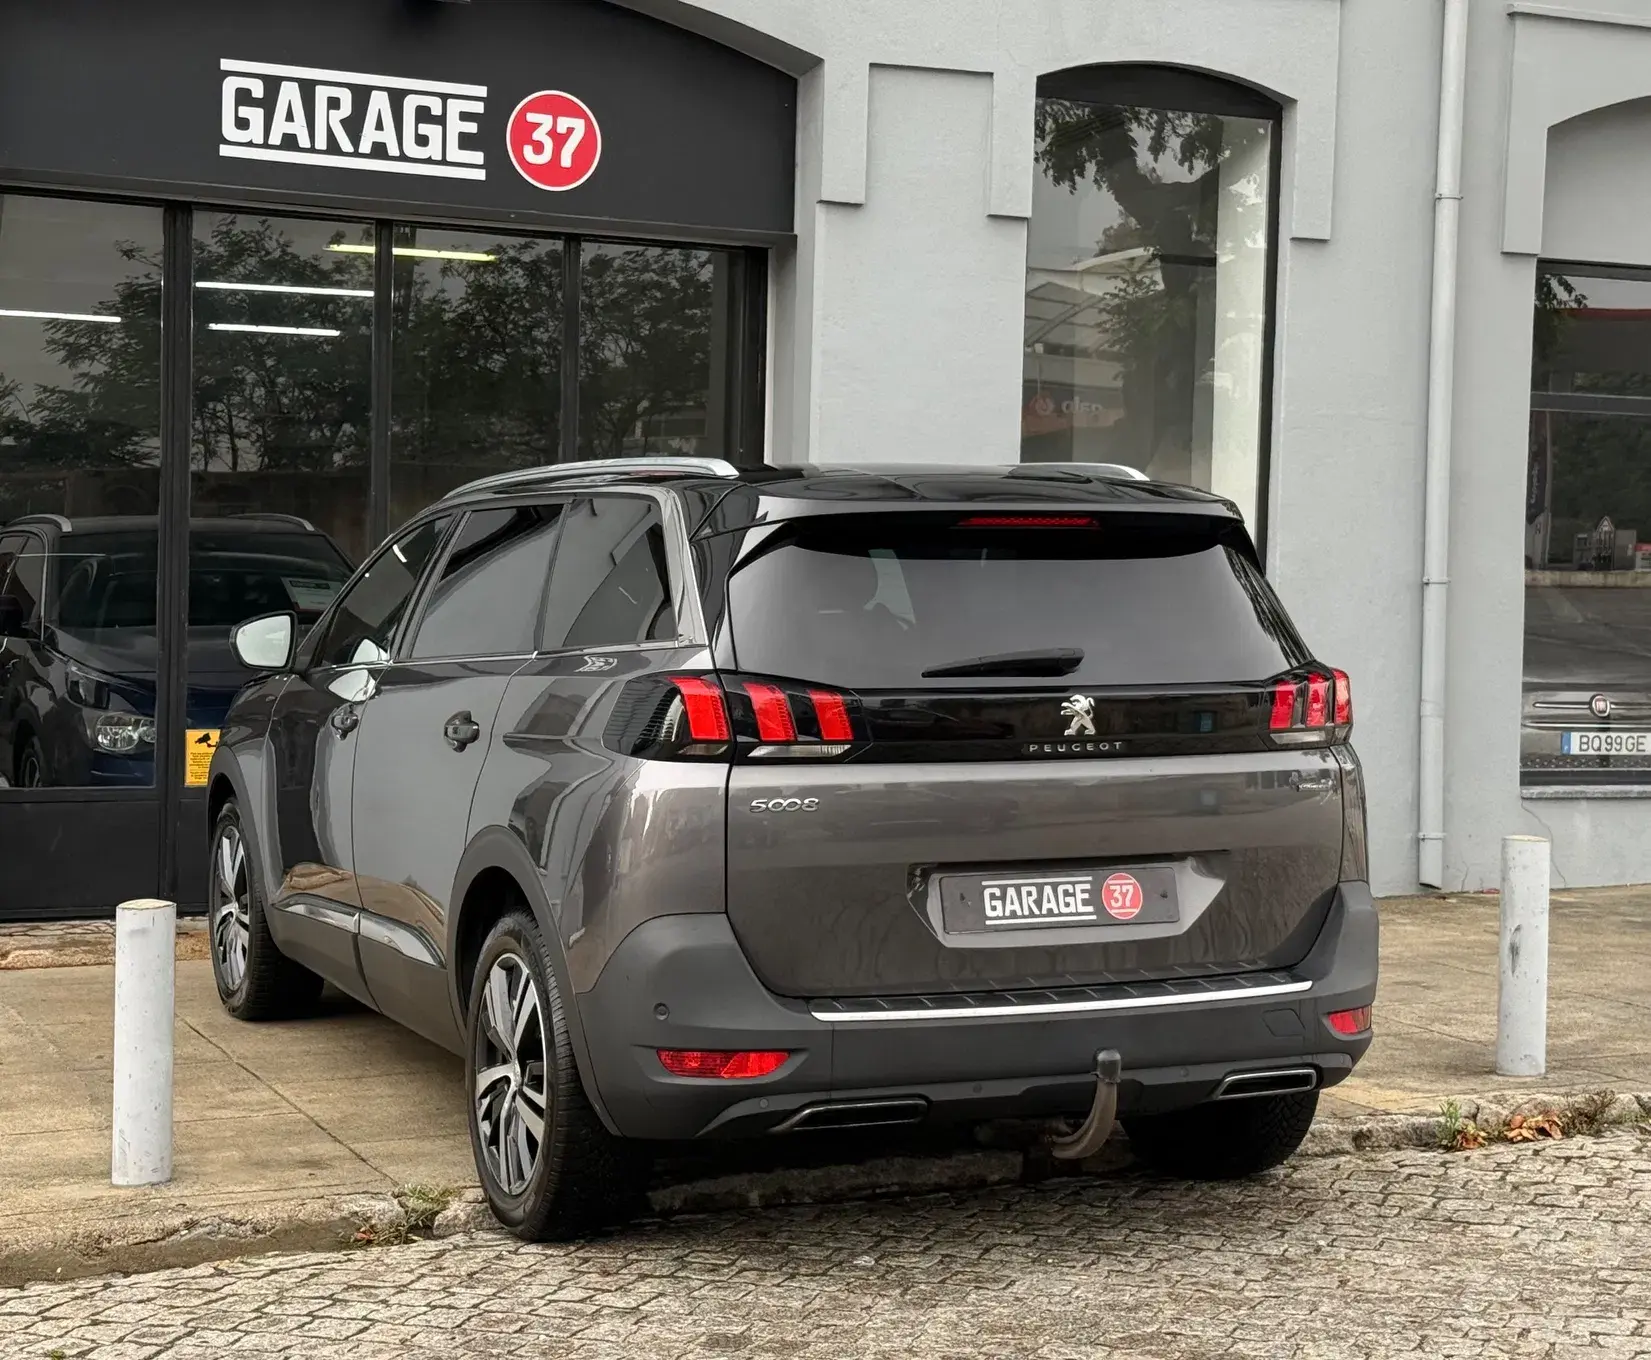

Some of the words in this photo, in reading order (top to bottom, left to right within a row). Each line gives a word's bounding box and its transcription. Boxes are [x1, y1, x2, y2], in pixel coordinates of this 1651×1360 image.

[222, 76, 485, 165] GARAGE
[523, 112, 586, 169] 37
[1029, 742, 1122, 752] PEUGEOT
[750, 798, 819, 813] 5008
[983, 884, 1094, 918] GARAGE
[1109, 885, 1134, 908] 37
